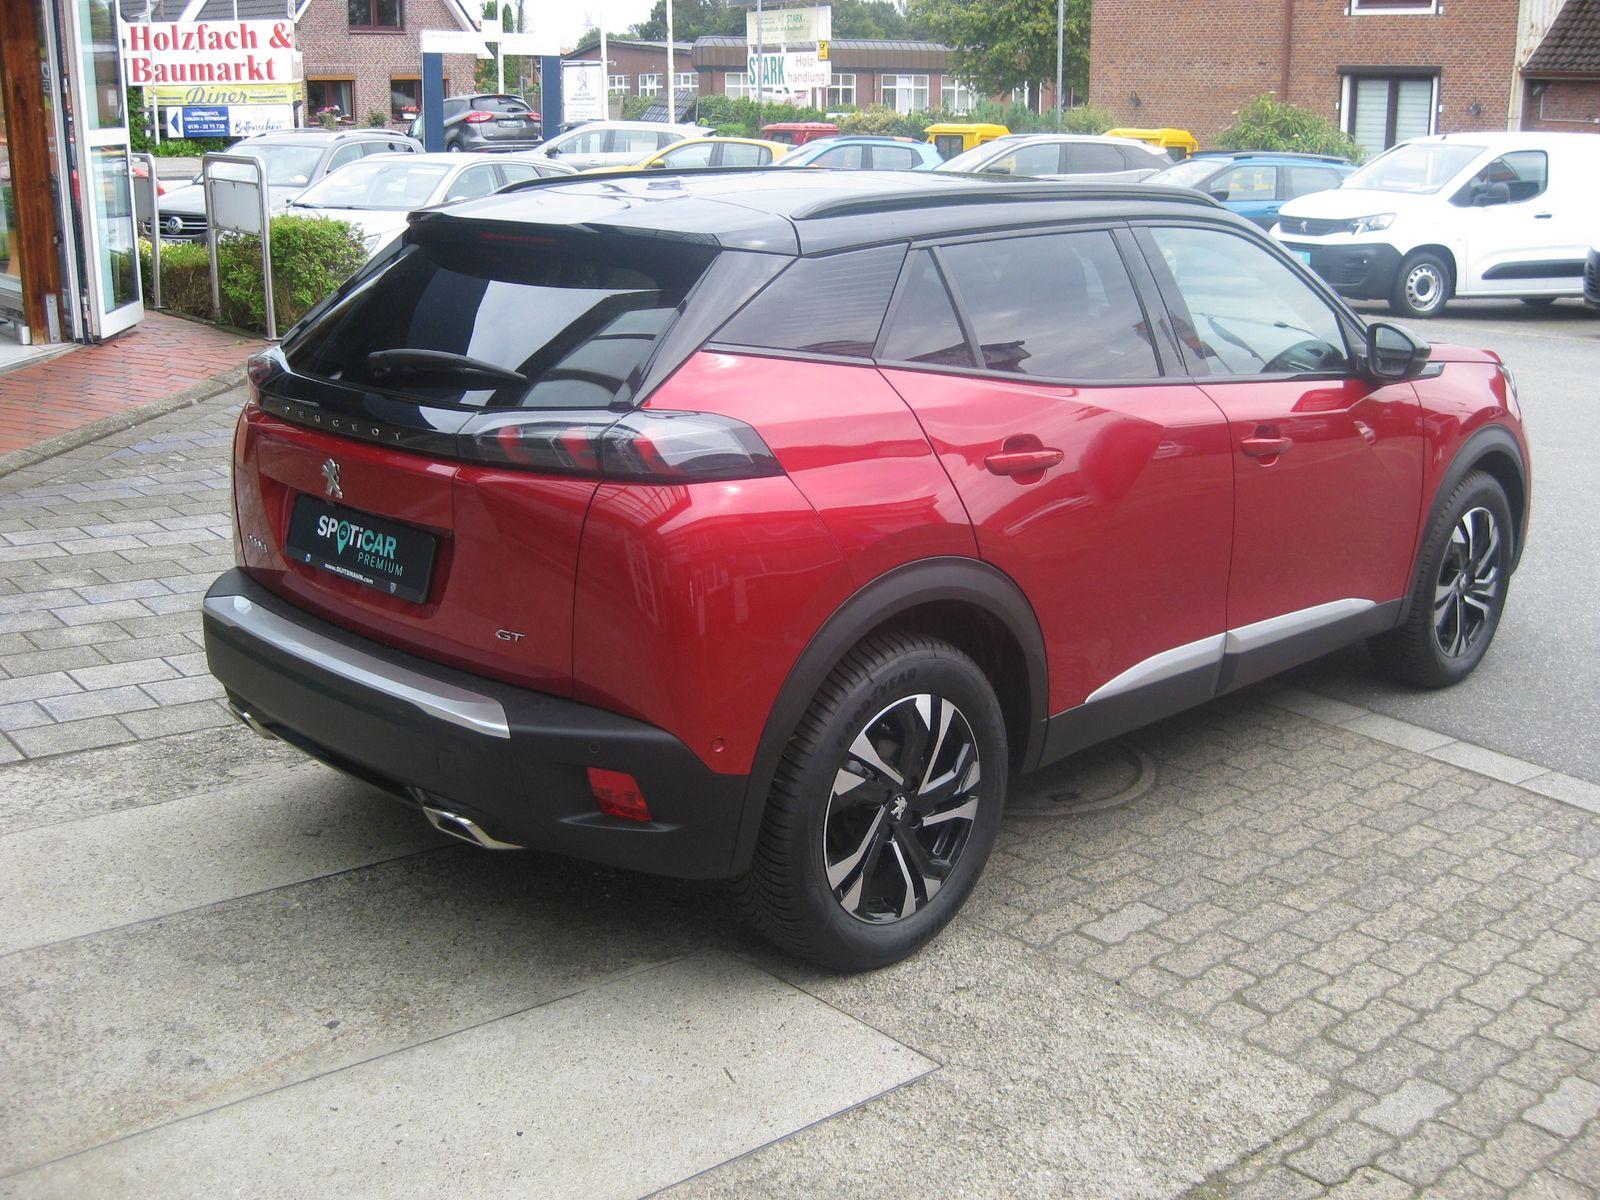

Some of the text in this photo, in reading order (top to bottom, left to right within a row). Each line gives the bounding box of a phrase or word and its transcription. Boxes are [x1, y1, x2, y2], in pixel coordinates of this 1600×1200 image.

[129, 22, 292, 51] Holzfach &
[131, 55, 277, 83] Baumarkt
[795, 55, 817, 68] Holz-
[787, 71, 825, 84] handlung
[185, 86, 248, 105] Diner
[357, 552, 404, 577] PREMIUM
[495, 629, 526, 642] GT
